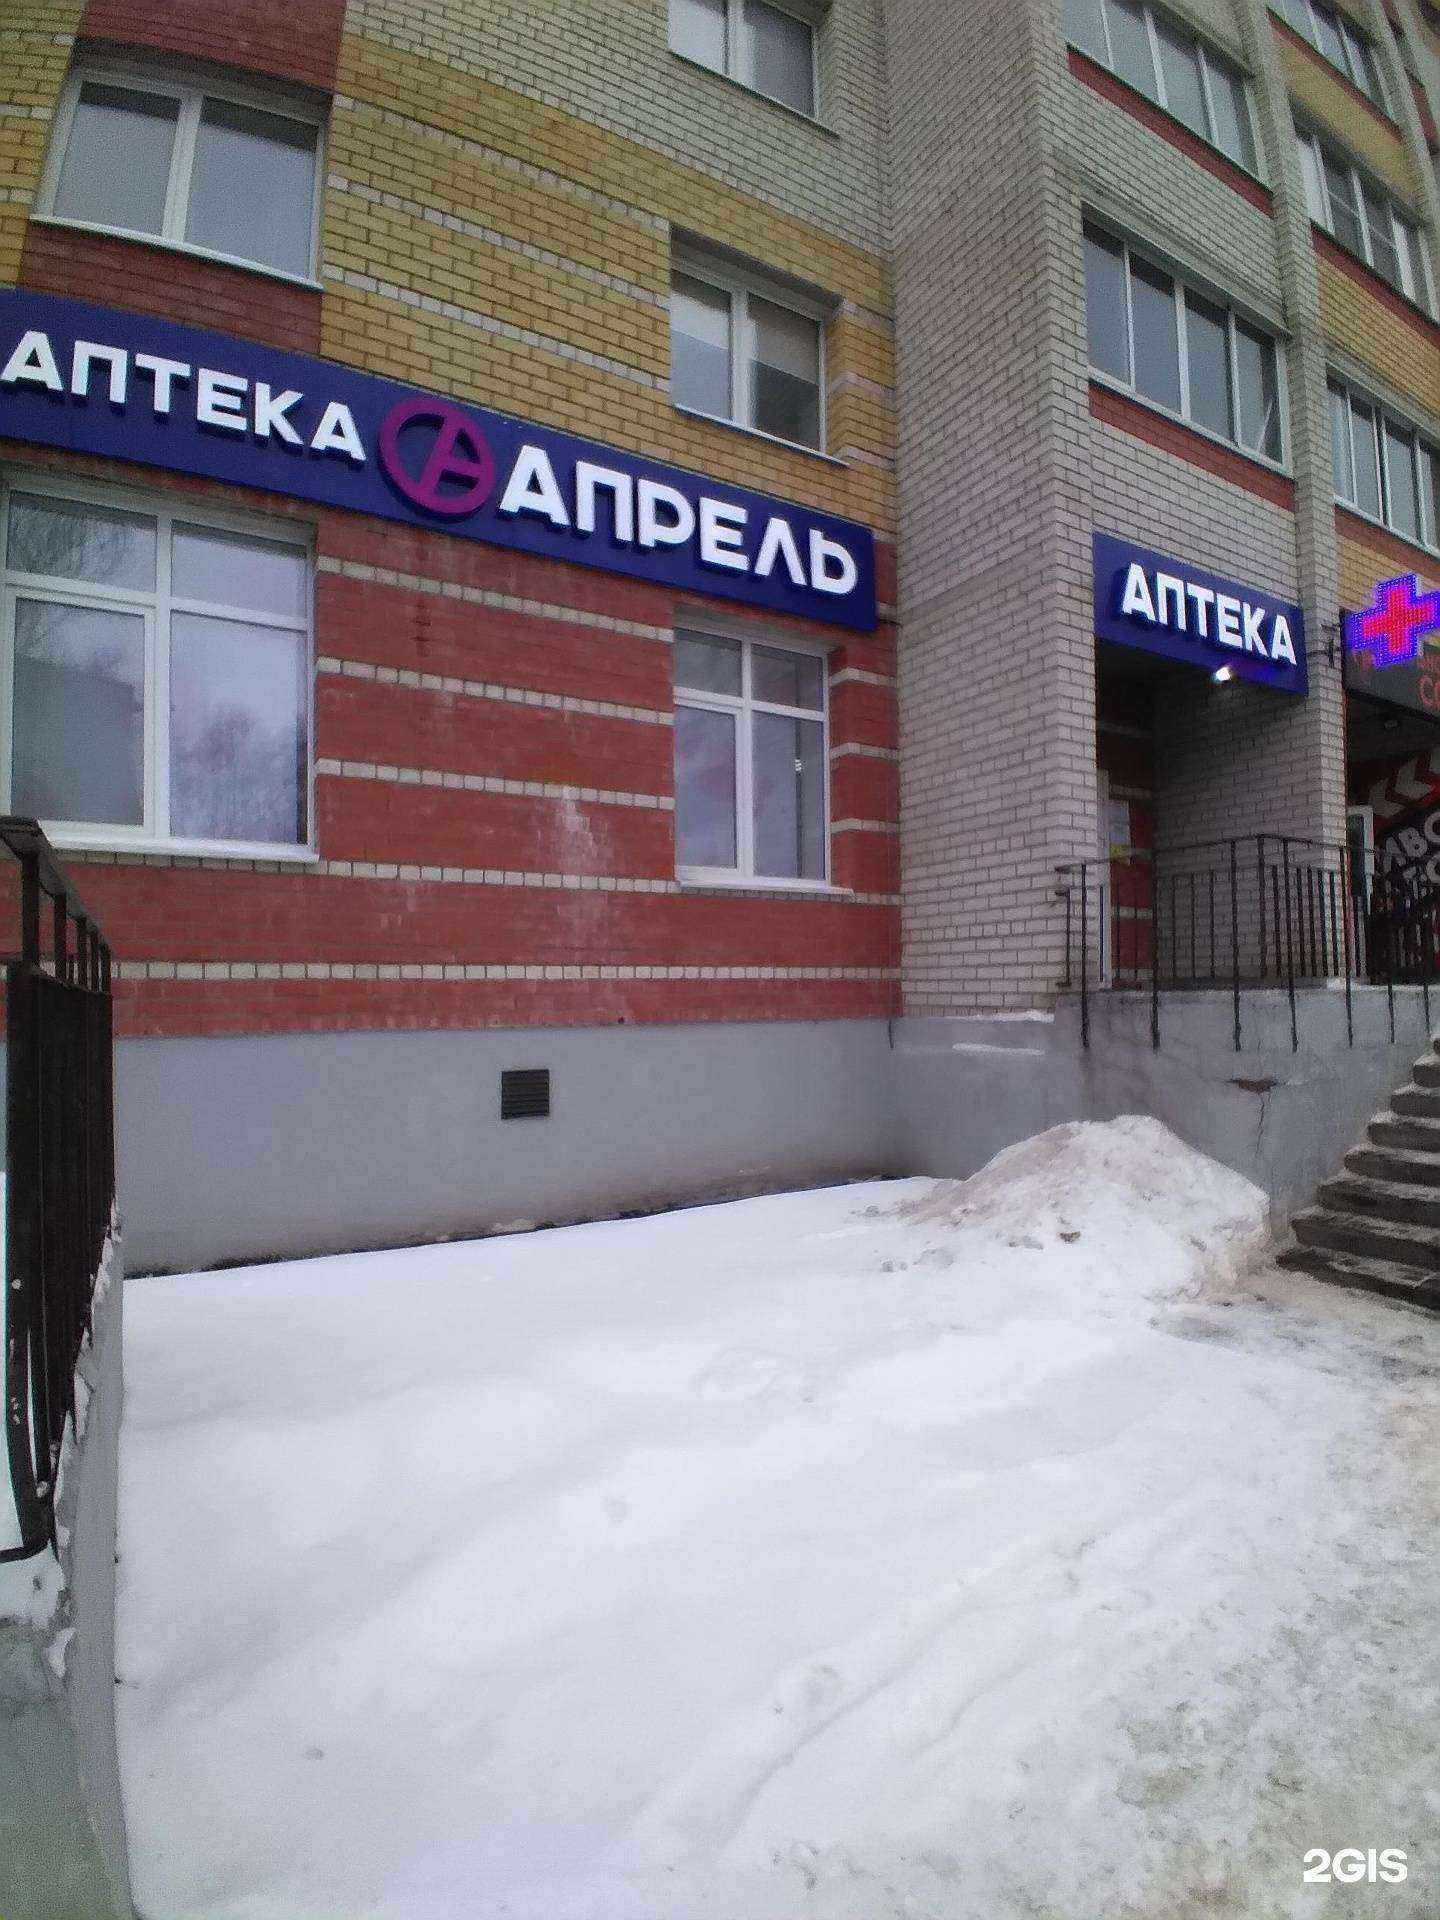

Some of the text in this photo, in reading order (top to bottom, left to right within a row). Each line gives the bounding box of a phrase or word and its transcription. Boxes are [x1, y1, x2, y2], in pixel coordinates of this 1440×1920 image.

[1, 330, 859, 596] АПТЕКА АПРЕЛЬ
[1122, 562, 1298, 666] АПТЕКА
